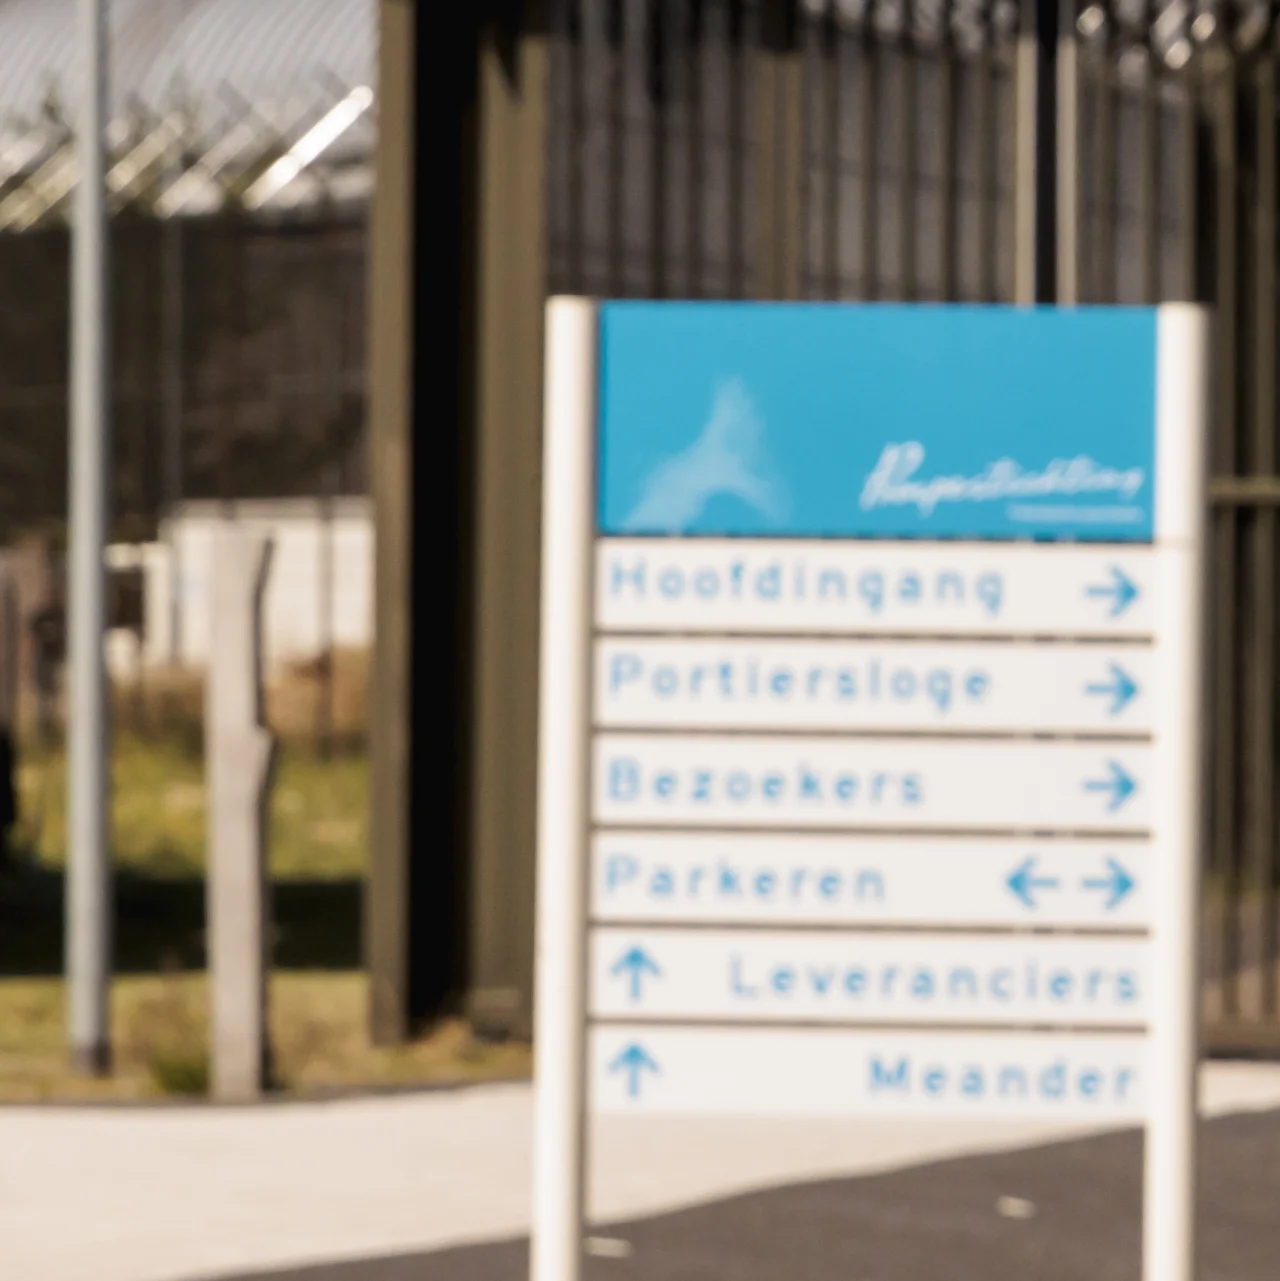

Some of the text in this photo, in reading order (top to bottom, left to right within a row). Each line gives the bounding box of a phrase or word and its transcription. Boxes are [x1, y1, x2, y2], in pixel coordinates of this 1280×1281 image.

[609, 558, 1006, 616] Hoofdingang
[609, 651, 990, 713] Portiersloge
[607, 756, 926, 803] Bezoekers
[605, 851, 888, 901] Parkeren
[728, 949, 1140, 1002] Leveranciers
[867, 1053, 1138, 1101] Meander
